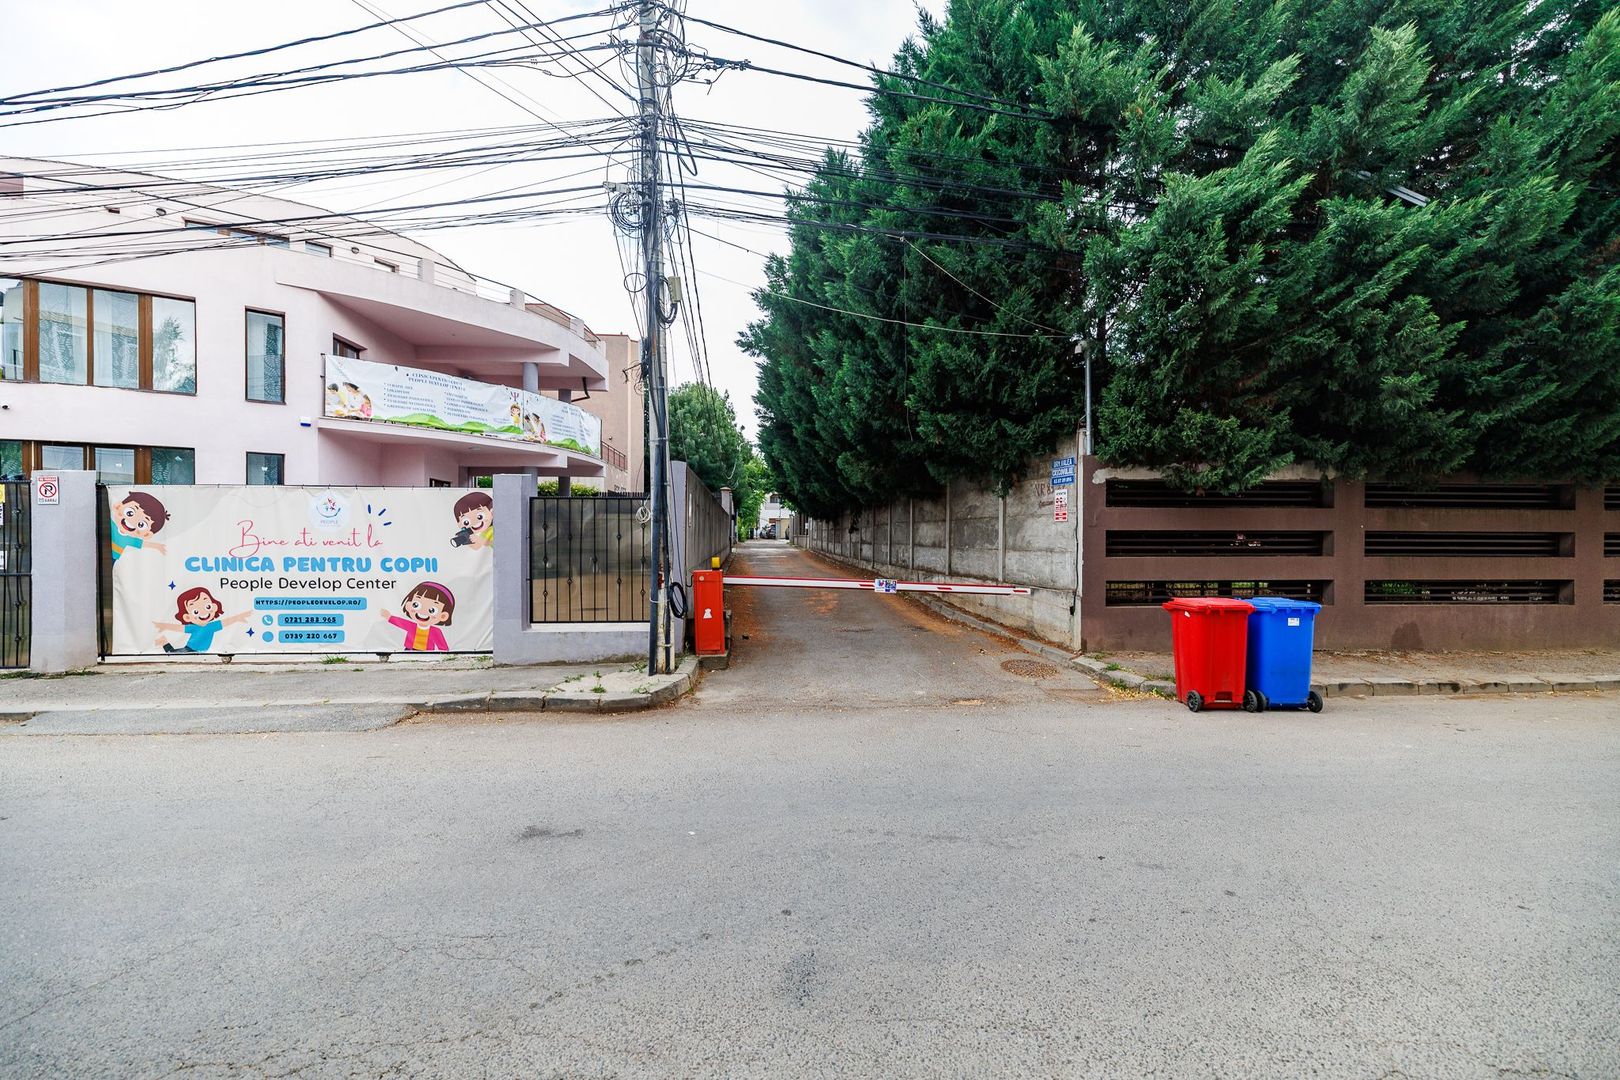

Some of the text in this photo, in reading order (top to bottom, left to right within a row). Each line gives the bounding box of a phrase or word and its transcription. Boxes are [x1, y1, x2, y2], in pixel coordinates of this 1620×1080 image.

[228, 519, 383, 559] Bine ati venit la
[184, 556, 439, 573] CLINICA PENTRU COPII
[220, 577, 397, 592] People Develop Center
